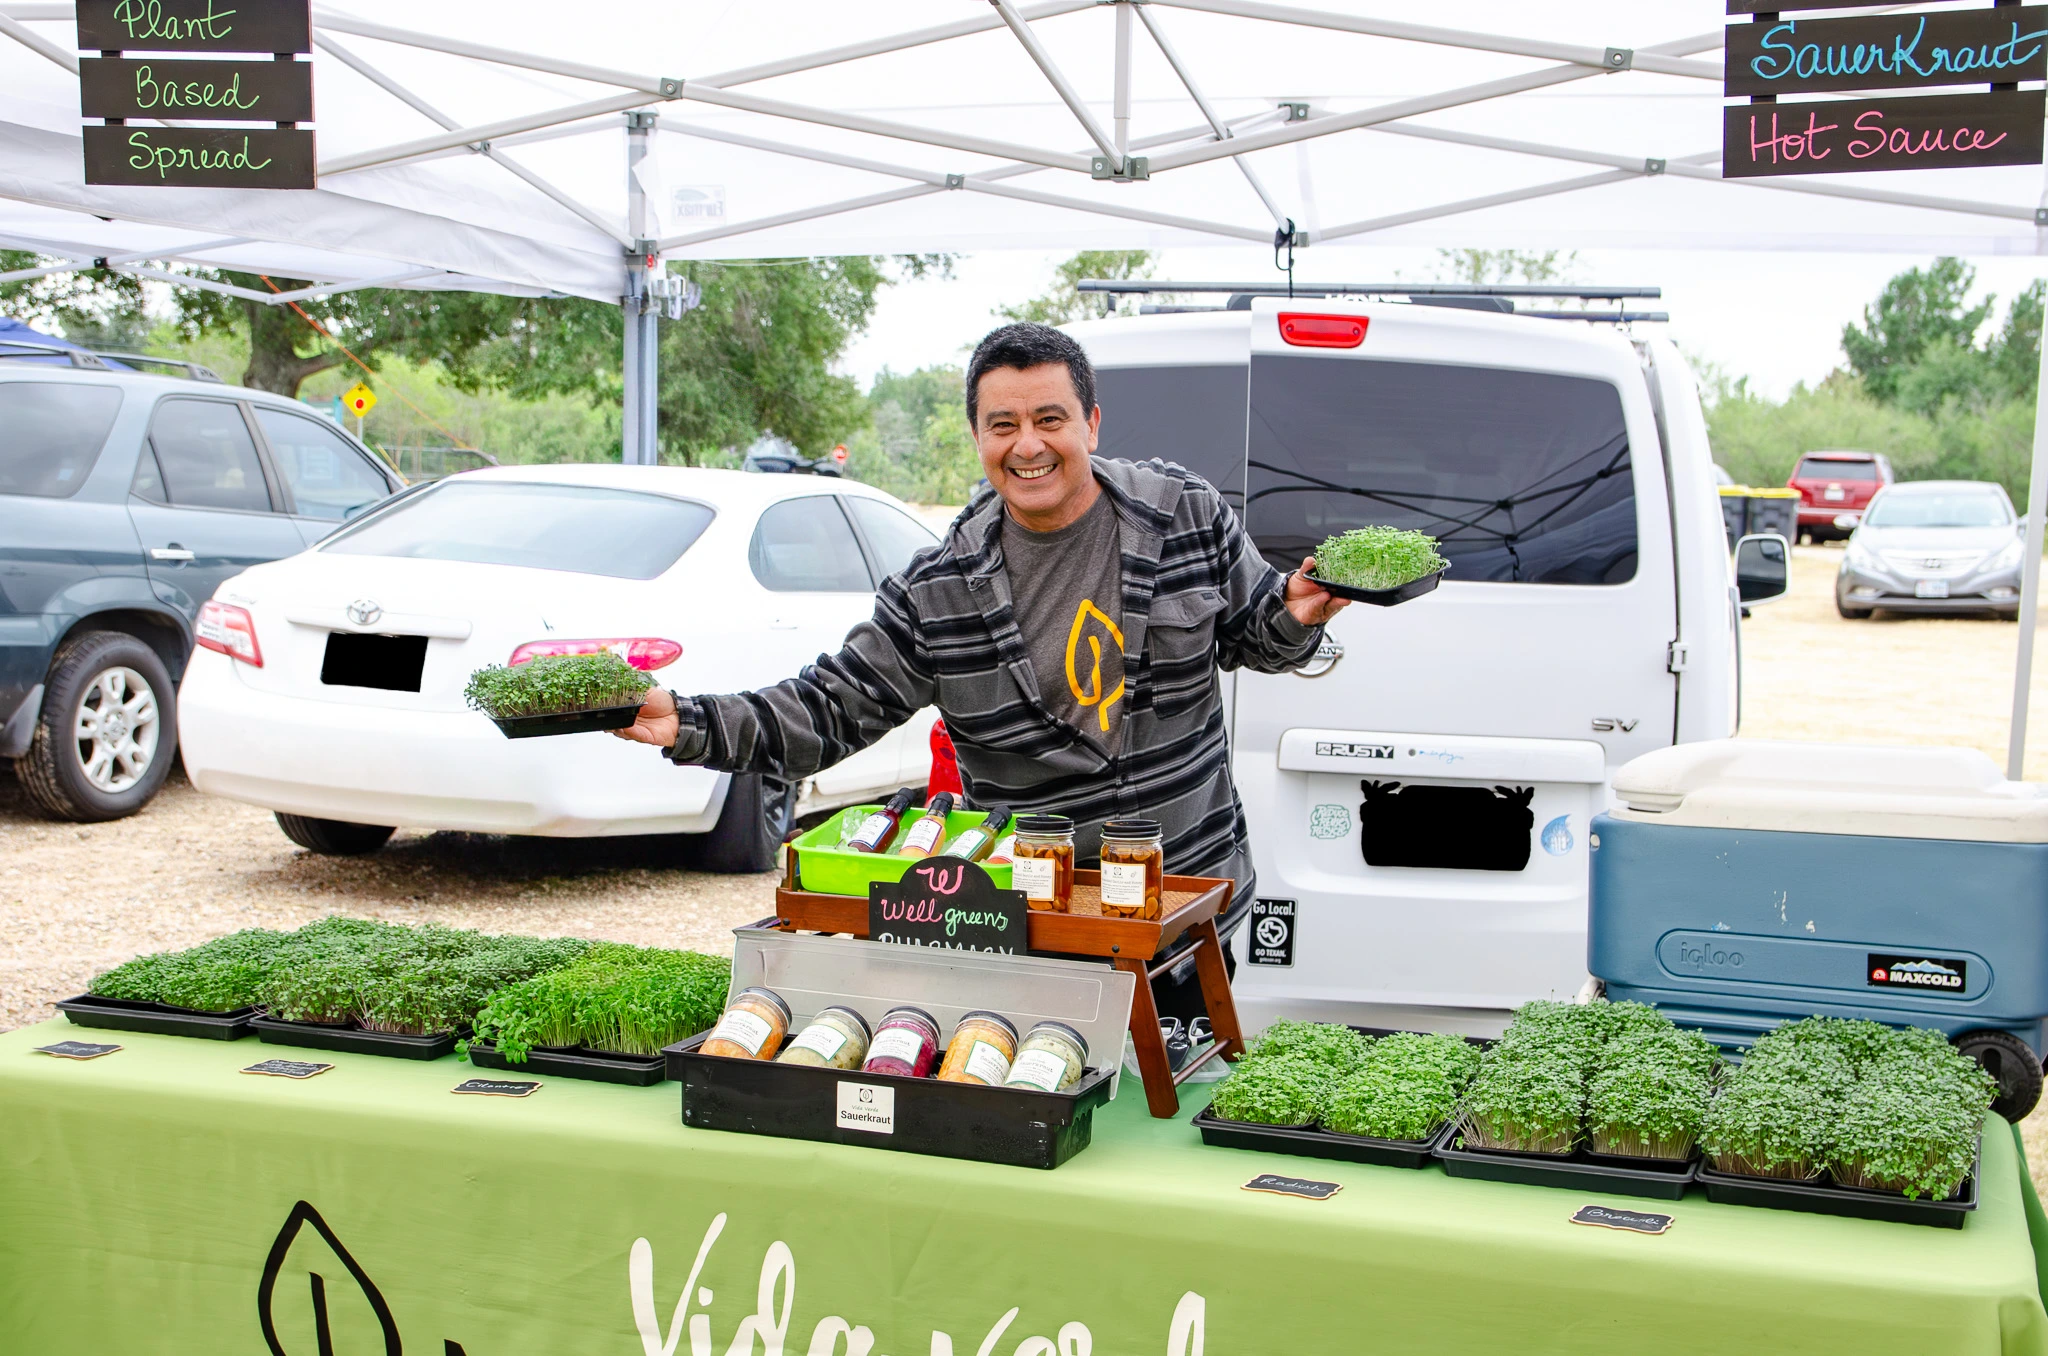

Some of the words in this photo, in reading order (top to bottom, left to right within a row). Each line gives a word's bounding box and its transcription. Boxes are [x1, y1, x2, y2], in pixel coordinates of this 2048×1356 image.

[114, 0, 237, 40] Plant
[136, 65, 260, 110] Based
[1750, 111, 1838, 164] Hot
[1847, 110, 2007, 159] Sauce
[128, 131, 272, 179] Spread
[1591, 717, 1639, 732] SV
[1331, 742, 1394, 759] RUSTY
[1252, 900, 1267, 915] Go
[1268, 901, 1295, 916] Local.
[1255, 948, 1266, 957] GO
[1680, 941, 1745, 972] igloo
[1889, 971, 1962, 987] MAXCOLD
[465, 1081, 528, 1090] Cilantro
[840, 1109, 891, 1125] Sauerkraut
[1260, 1177, 1327, 1192] Radish
